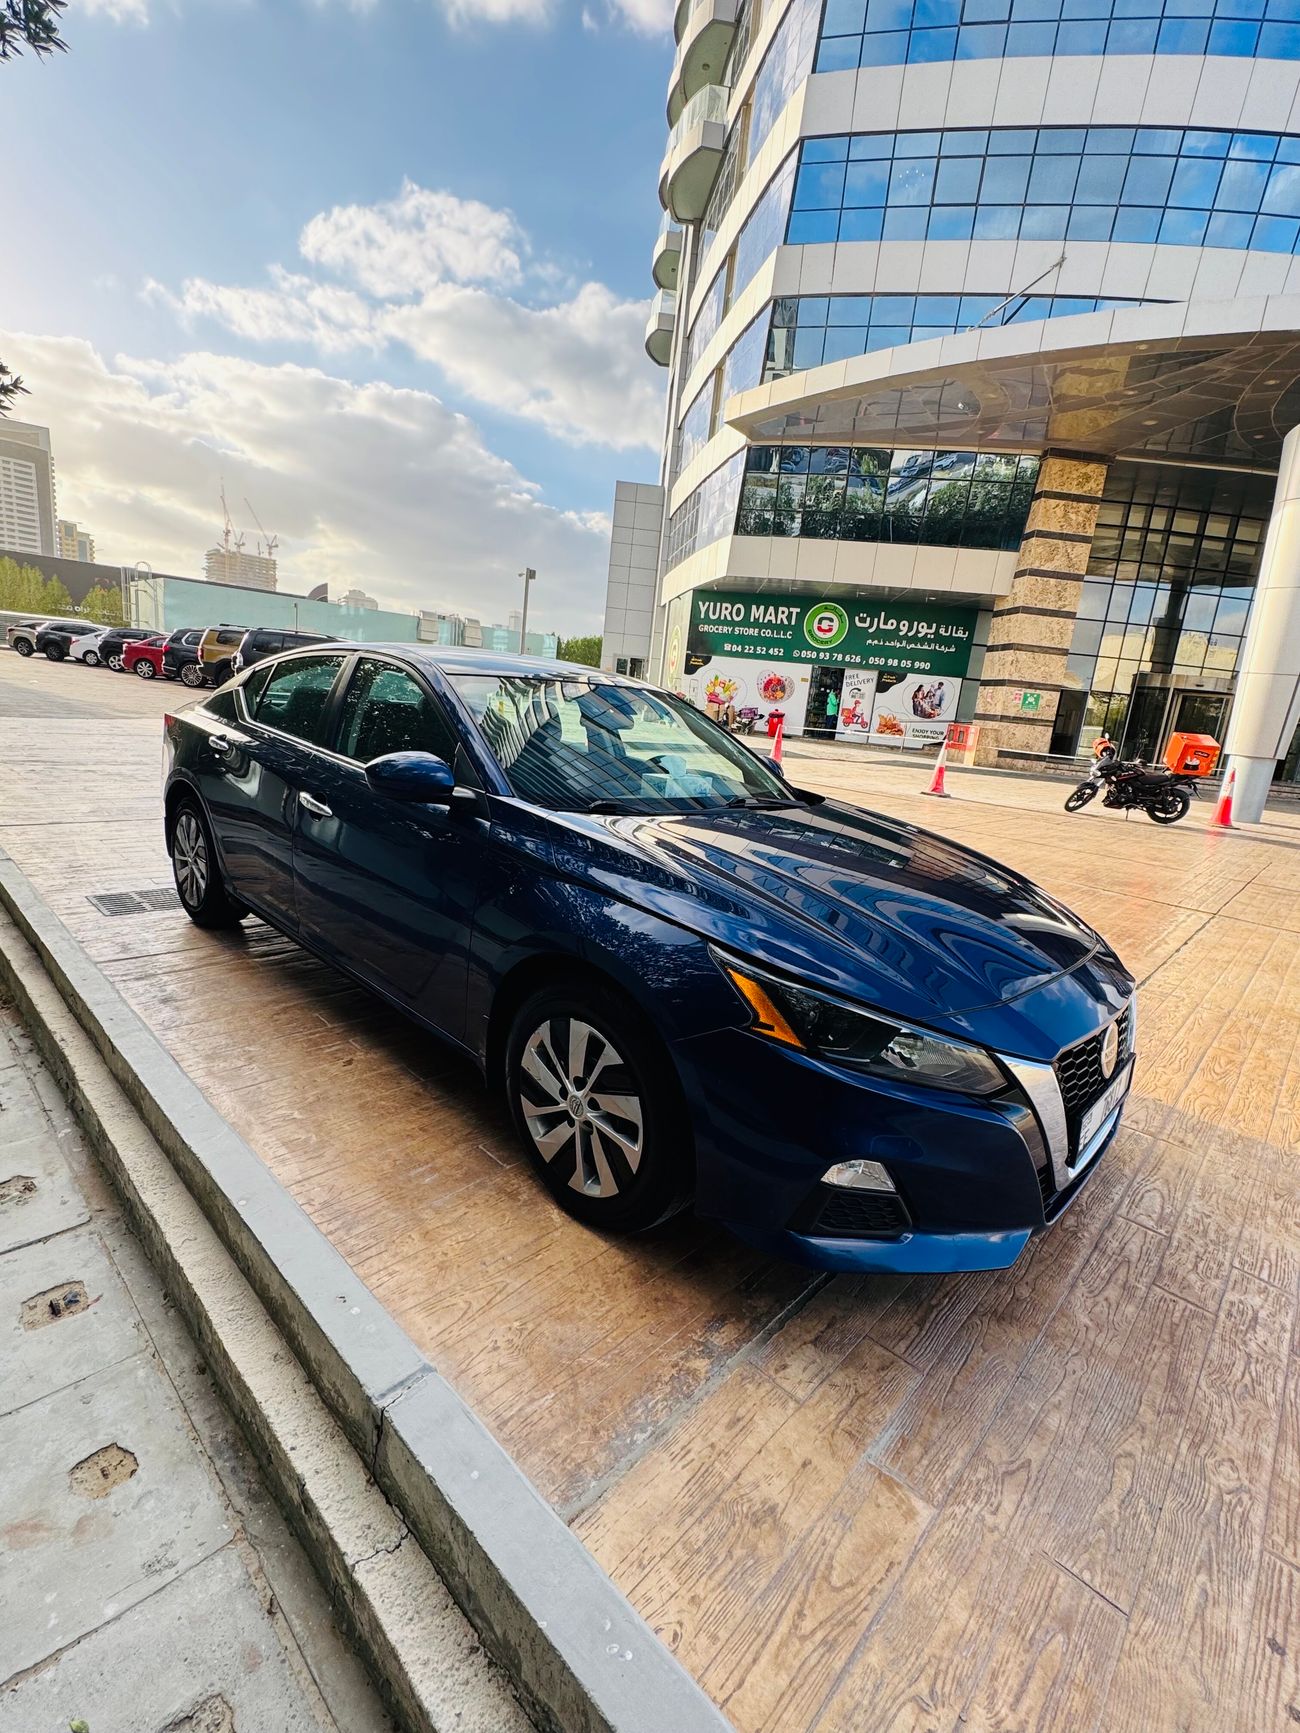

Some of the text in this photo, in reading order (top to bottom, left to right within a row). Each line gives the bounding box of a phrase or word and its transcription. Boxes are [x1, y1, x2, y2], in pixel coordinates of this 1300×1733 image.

[698, 601, 800, 625] YURO MART
[698, 624, 793, 639] GROCERY STORE CO.L.L.C
[939, 624, 969, 640] بقالة
[731, 644, 784, 656] 04 22 52 452
[935, 644, 956, 653] شركة
[801, 650, 817, 659] 050
[819, 652, 830, 660] 93
[832, 653, 843, 661] 78
[844, 654, 861, 663] 626
[868, 656, 885, 665] 050
[887, 658, 899, 667] 98
[900, 659, 912, 668] 05
[914, 661, 931, 670] 990
[845, 673, 859, 681] FREE
[845, 677, 874, 688] DELIVERY
